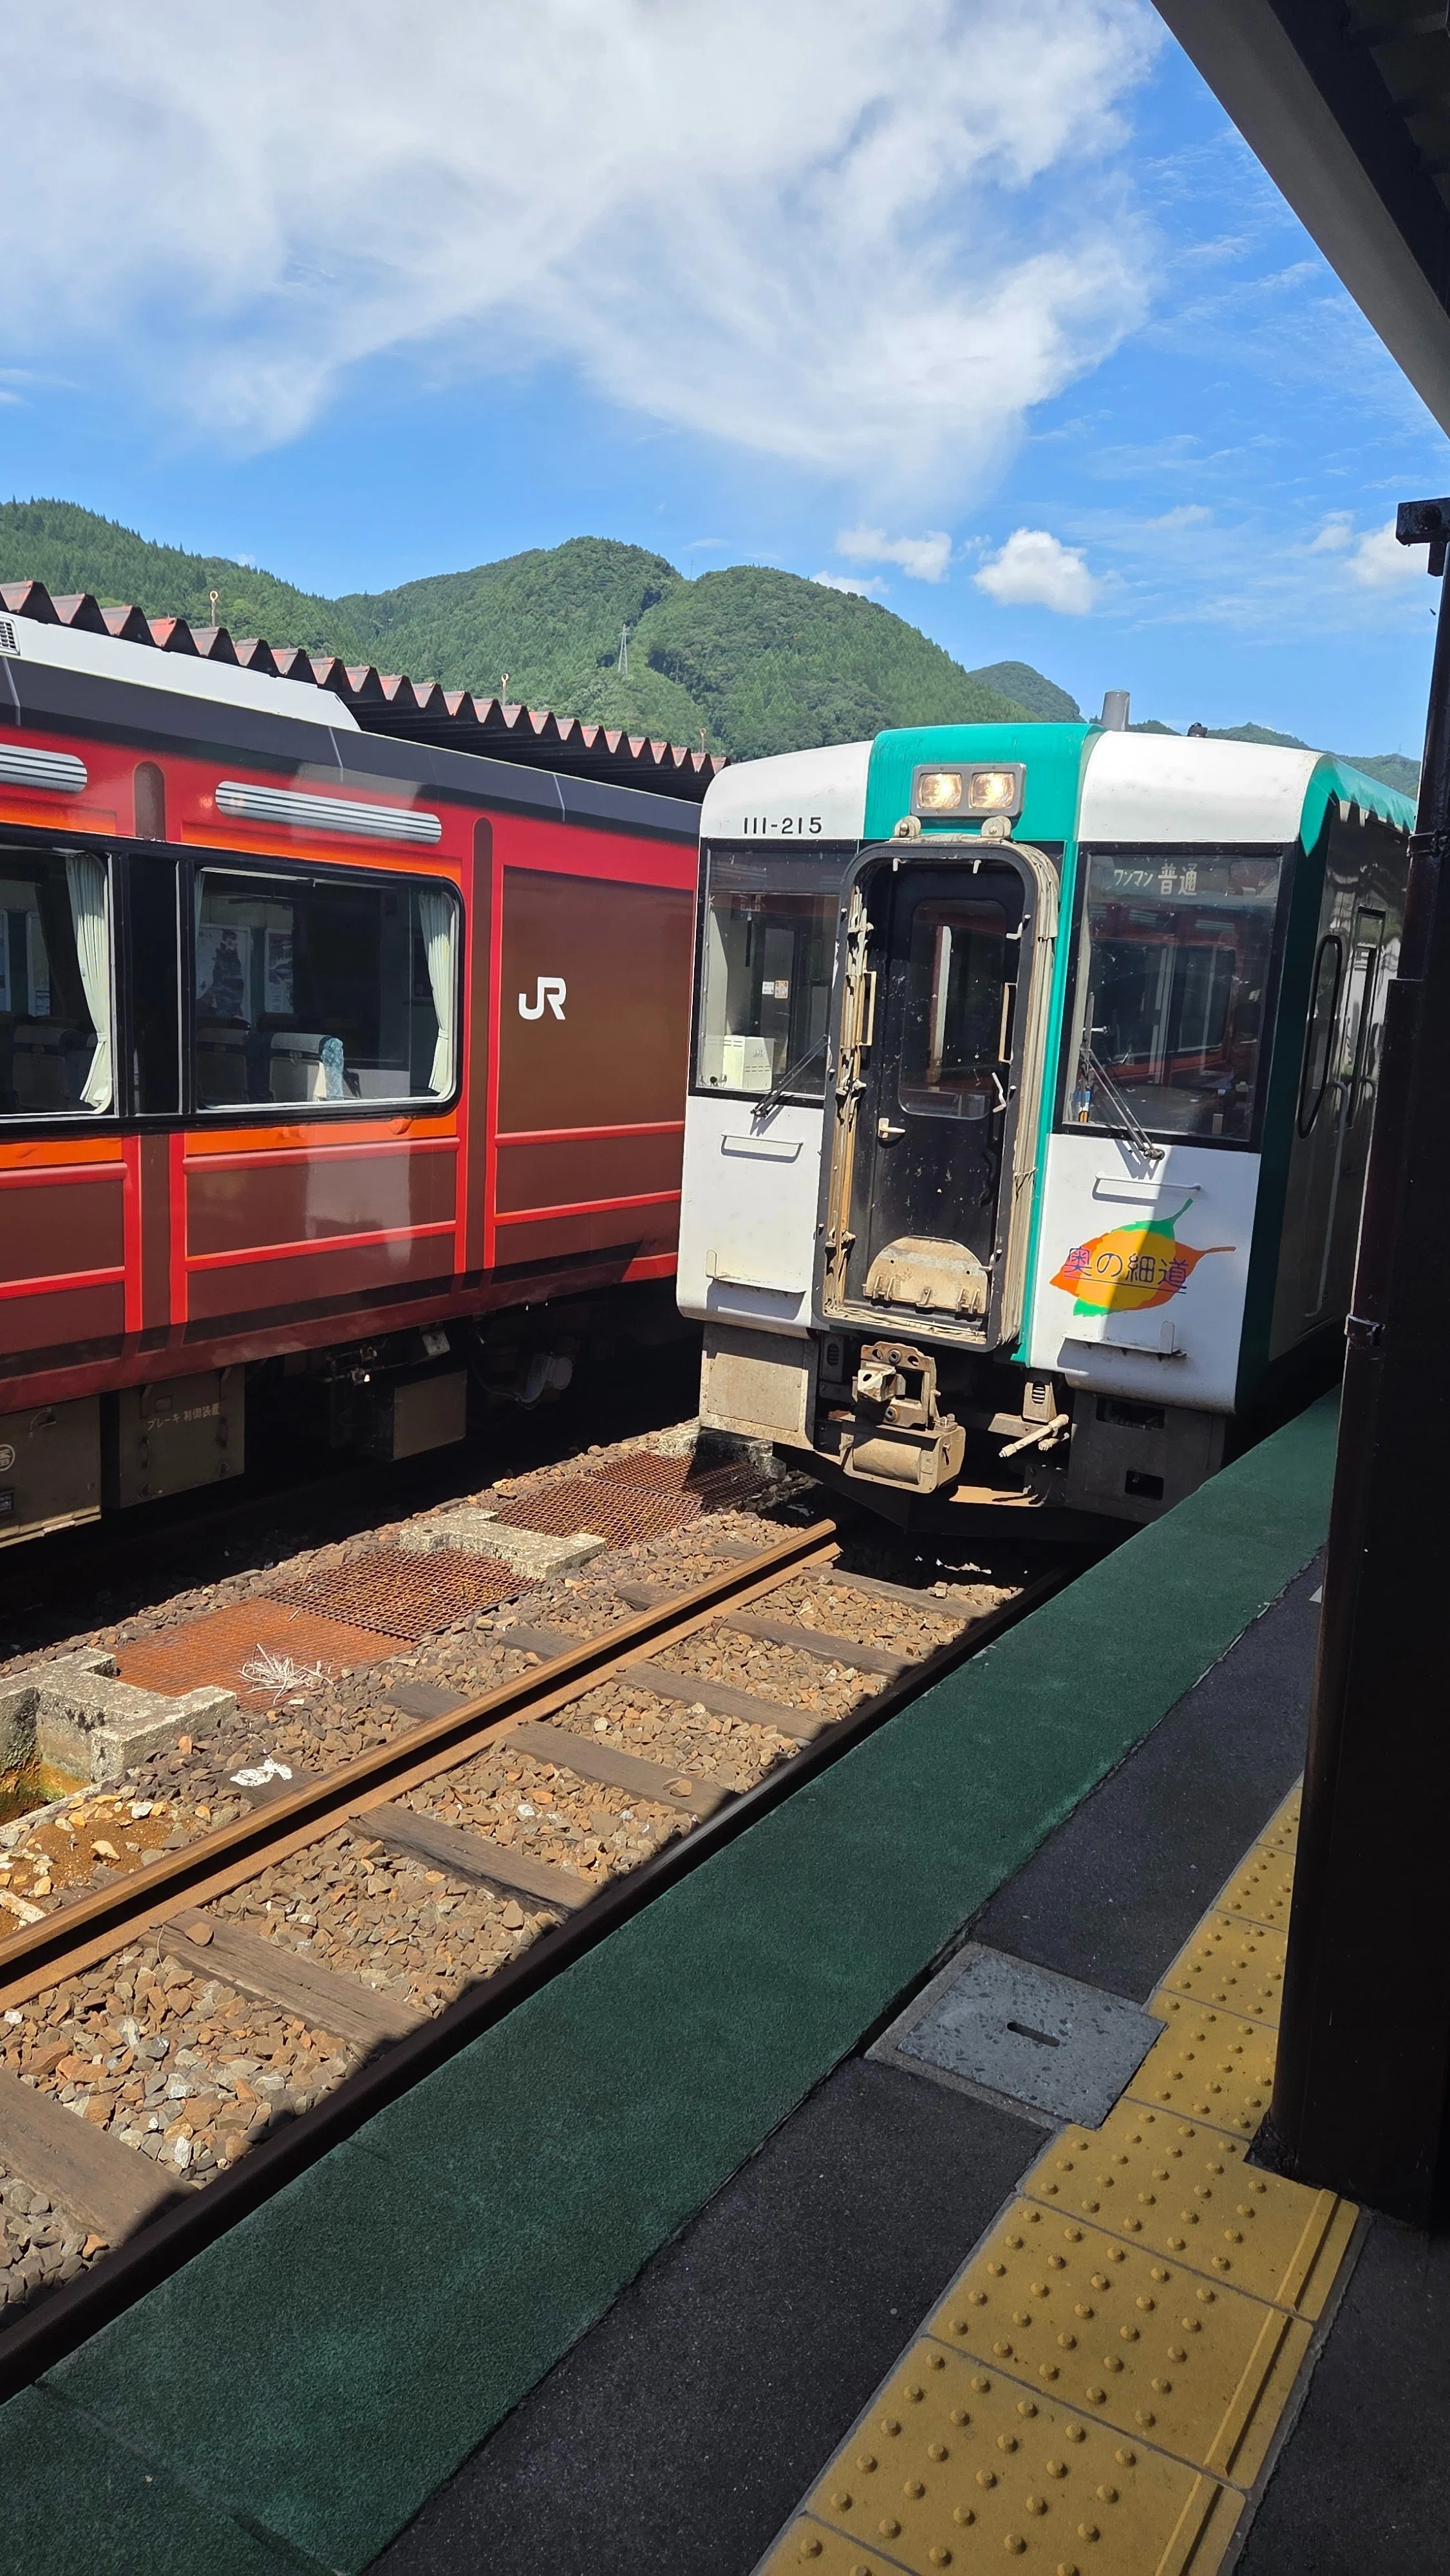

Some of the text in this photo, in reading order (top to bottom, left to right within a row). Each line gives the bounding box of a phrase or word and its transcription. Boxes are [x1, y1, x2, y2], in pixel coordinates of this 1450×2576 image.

[744, 817, 822, 835] 111-215
[1114, 862, 1198, 896] ワンマン 普通
[518, 976, 567, 1020] JR
[1064, 1246, 1187, 1289] 奥の細道
